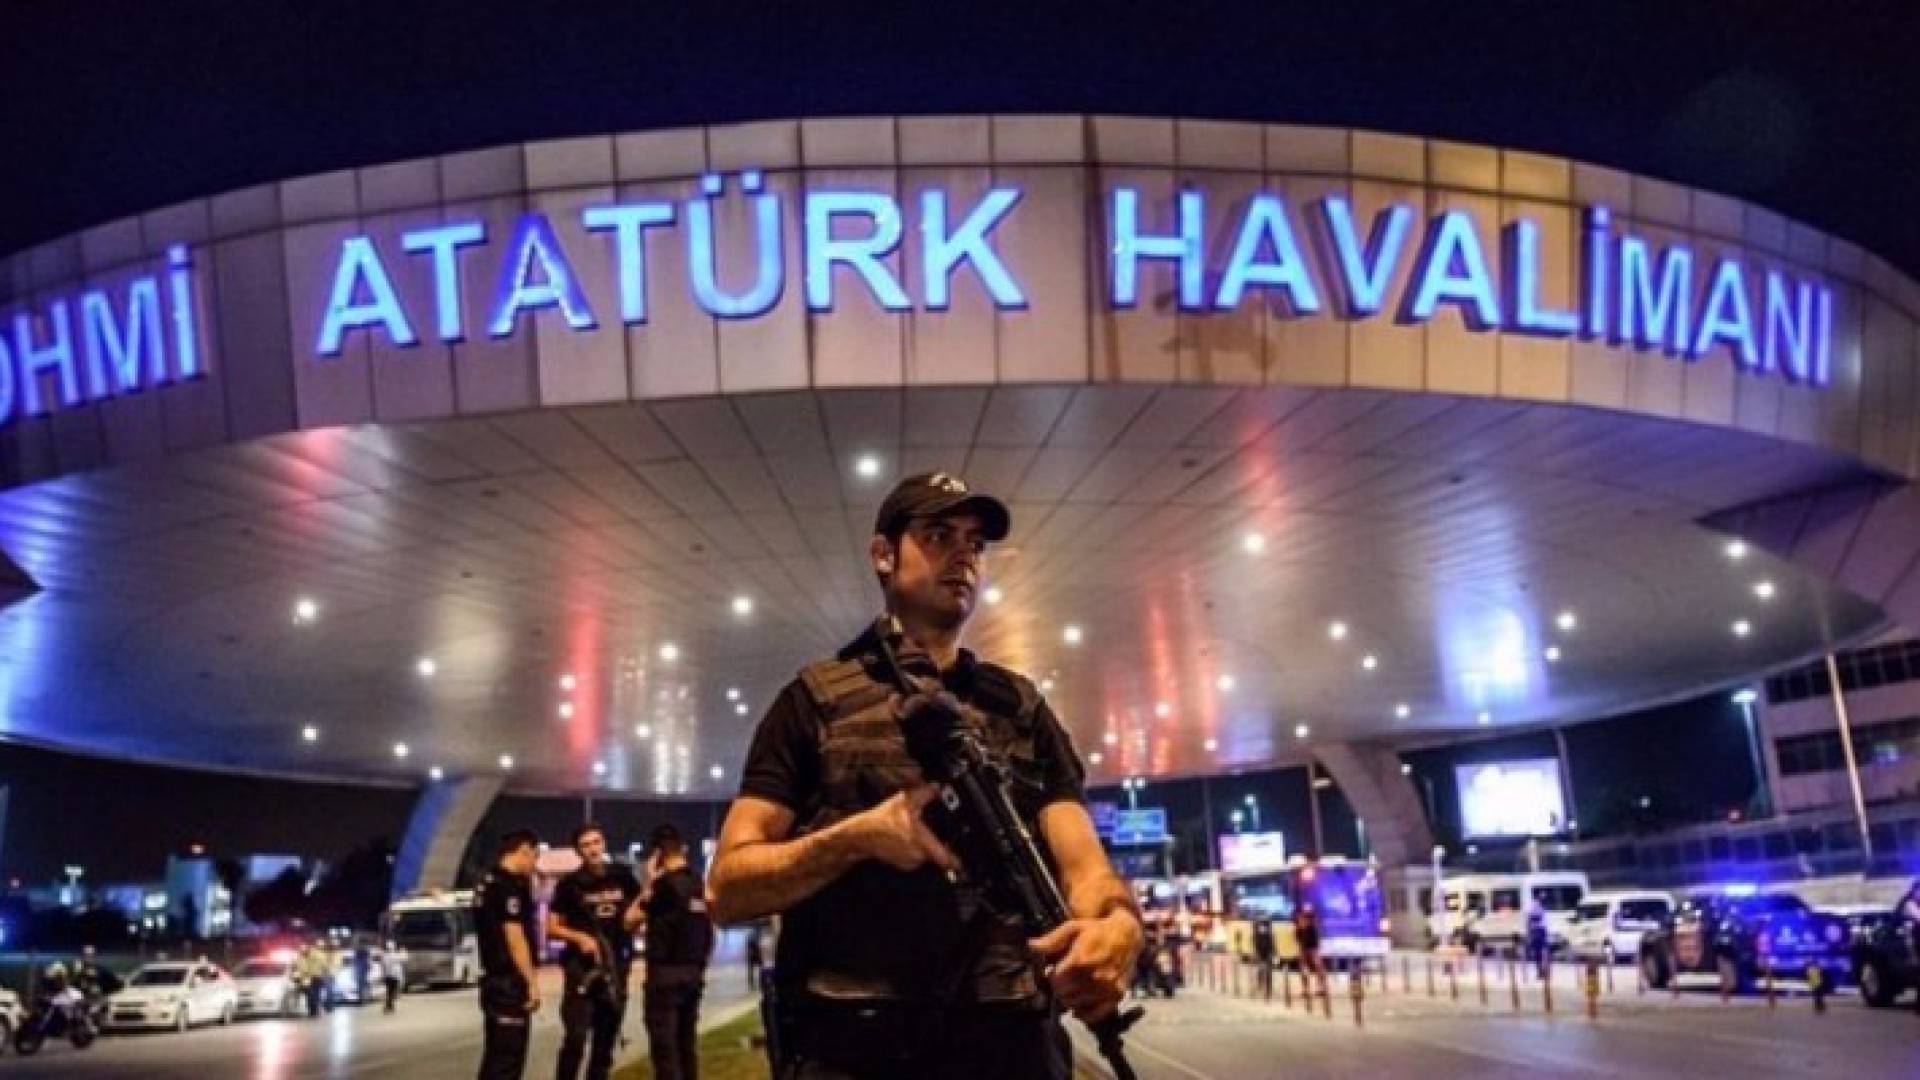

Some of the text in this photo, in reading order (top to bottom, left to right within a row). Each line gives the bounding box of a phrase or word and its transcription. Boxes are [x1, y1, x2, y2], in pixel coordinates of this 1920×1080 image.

[0, 170, 1832, 425] HMİ ATATÜRK HAVALİMANI
